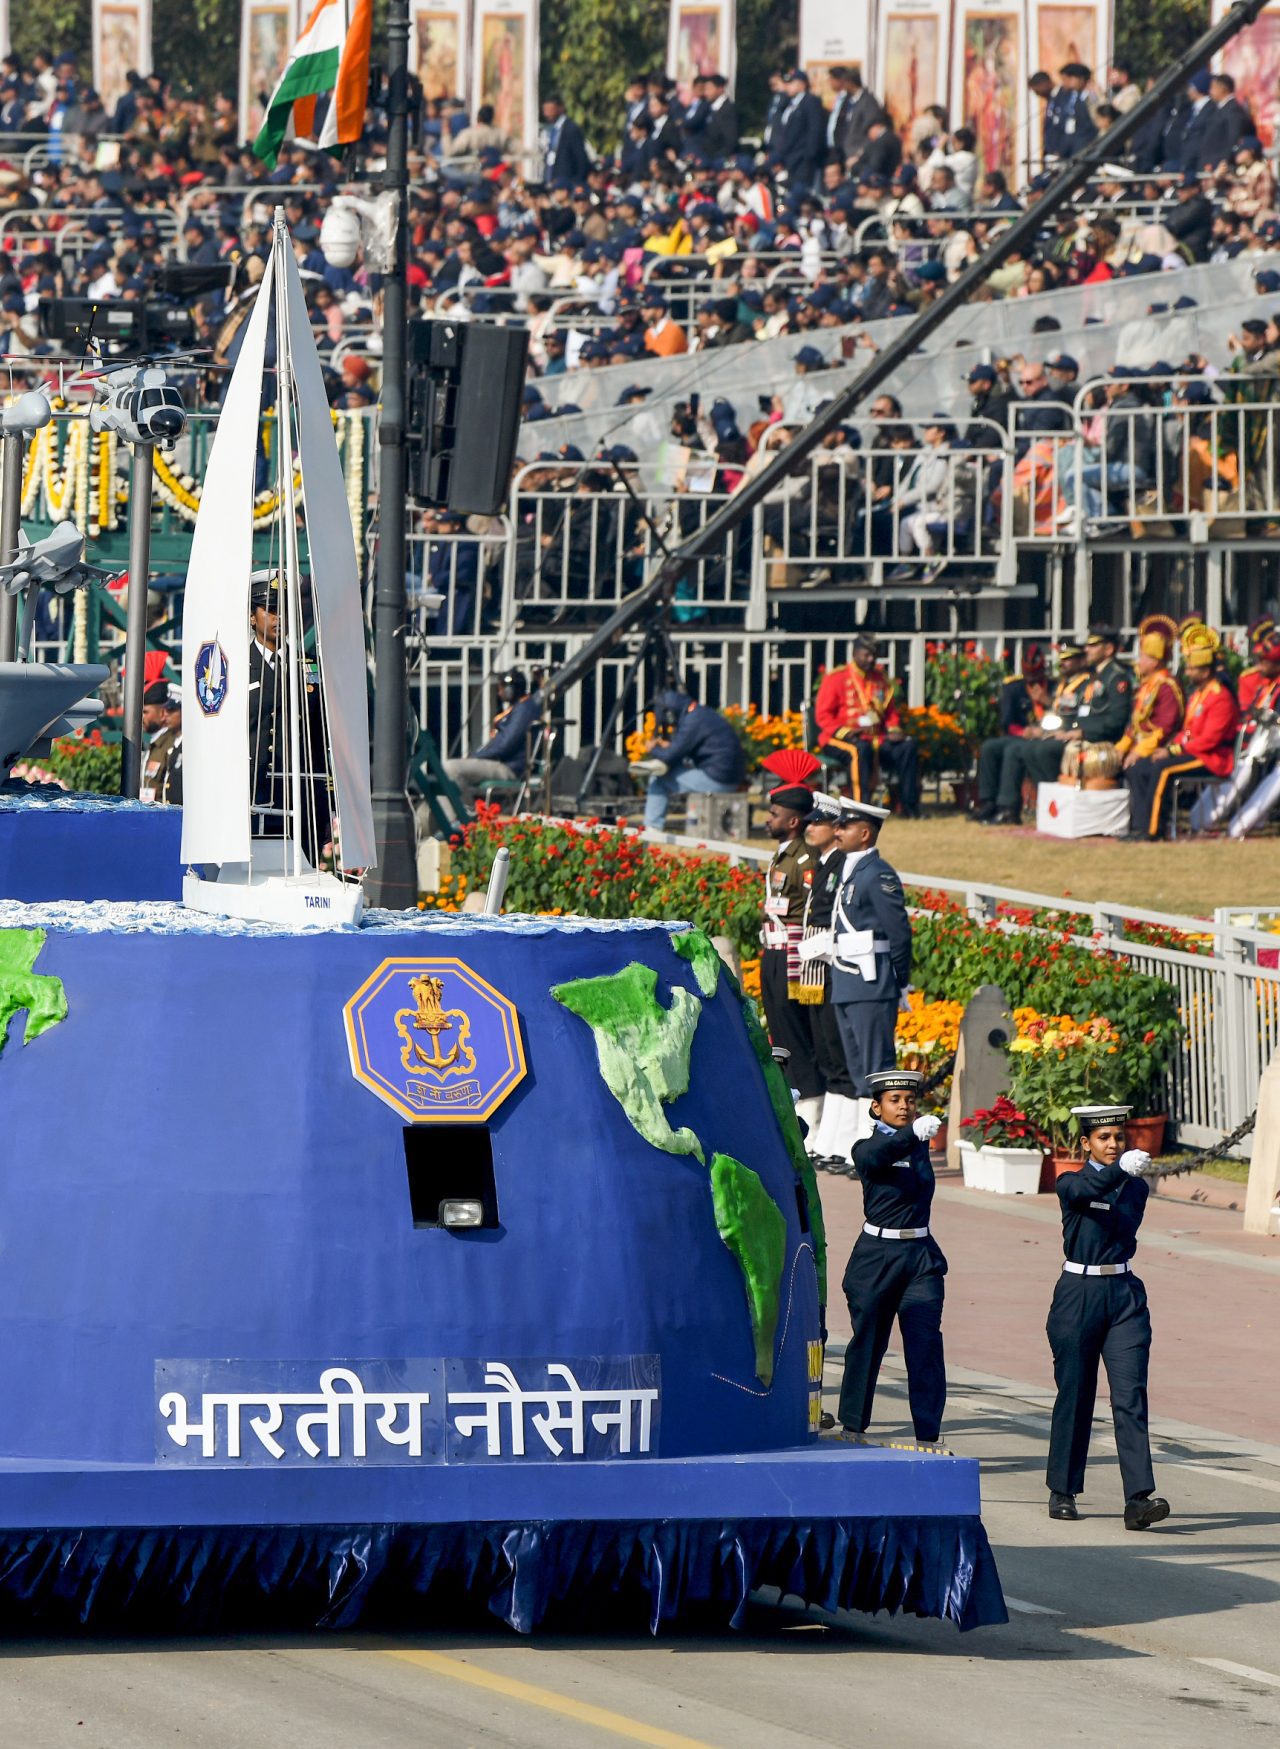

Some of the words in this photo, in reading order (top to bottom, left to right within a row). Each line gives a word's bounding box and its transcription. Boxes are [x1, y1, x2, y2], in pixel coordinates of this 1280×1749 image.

[304, 895, 331, 909] TARINI
[159, 1367, 429, 1459] भारतीय
[448, 1362, 659, 1457] नौसेना
